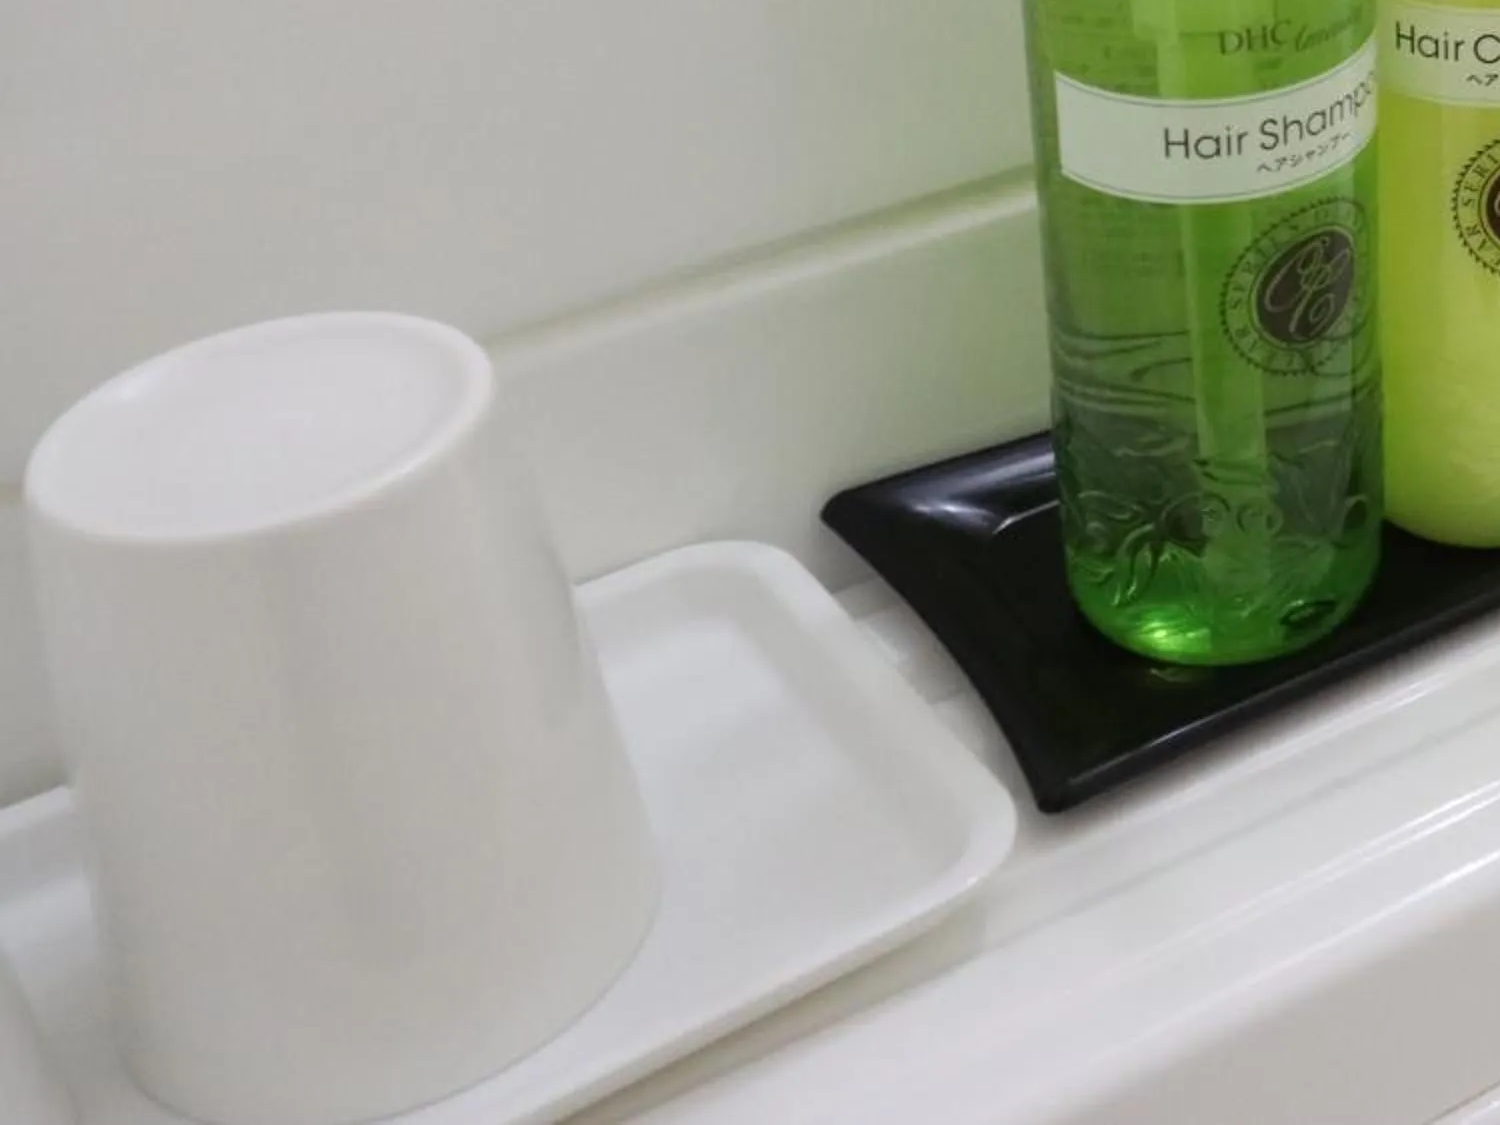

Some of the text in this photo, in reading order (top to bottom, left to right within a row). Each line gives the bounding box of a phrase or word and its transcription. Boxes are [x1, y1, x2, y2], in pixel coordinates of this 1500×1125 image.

[1218, 18, 1292, 56] DHC
[1395, 19, 1465, 62] Hair
[1164, 125, 1249, 161] Hair
